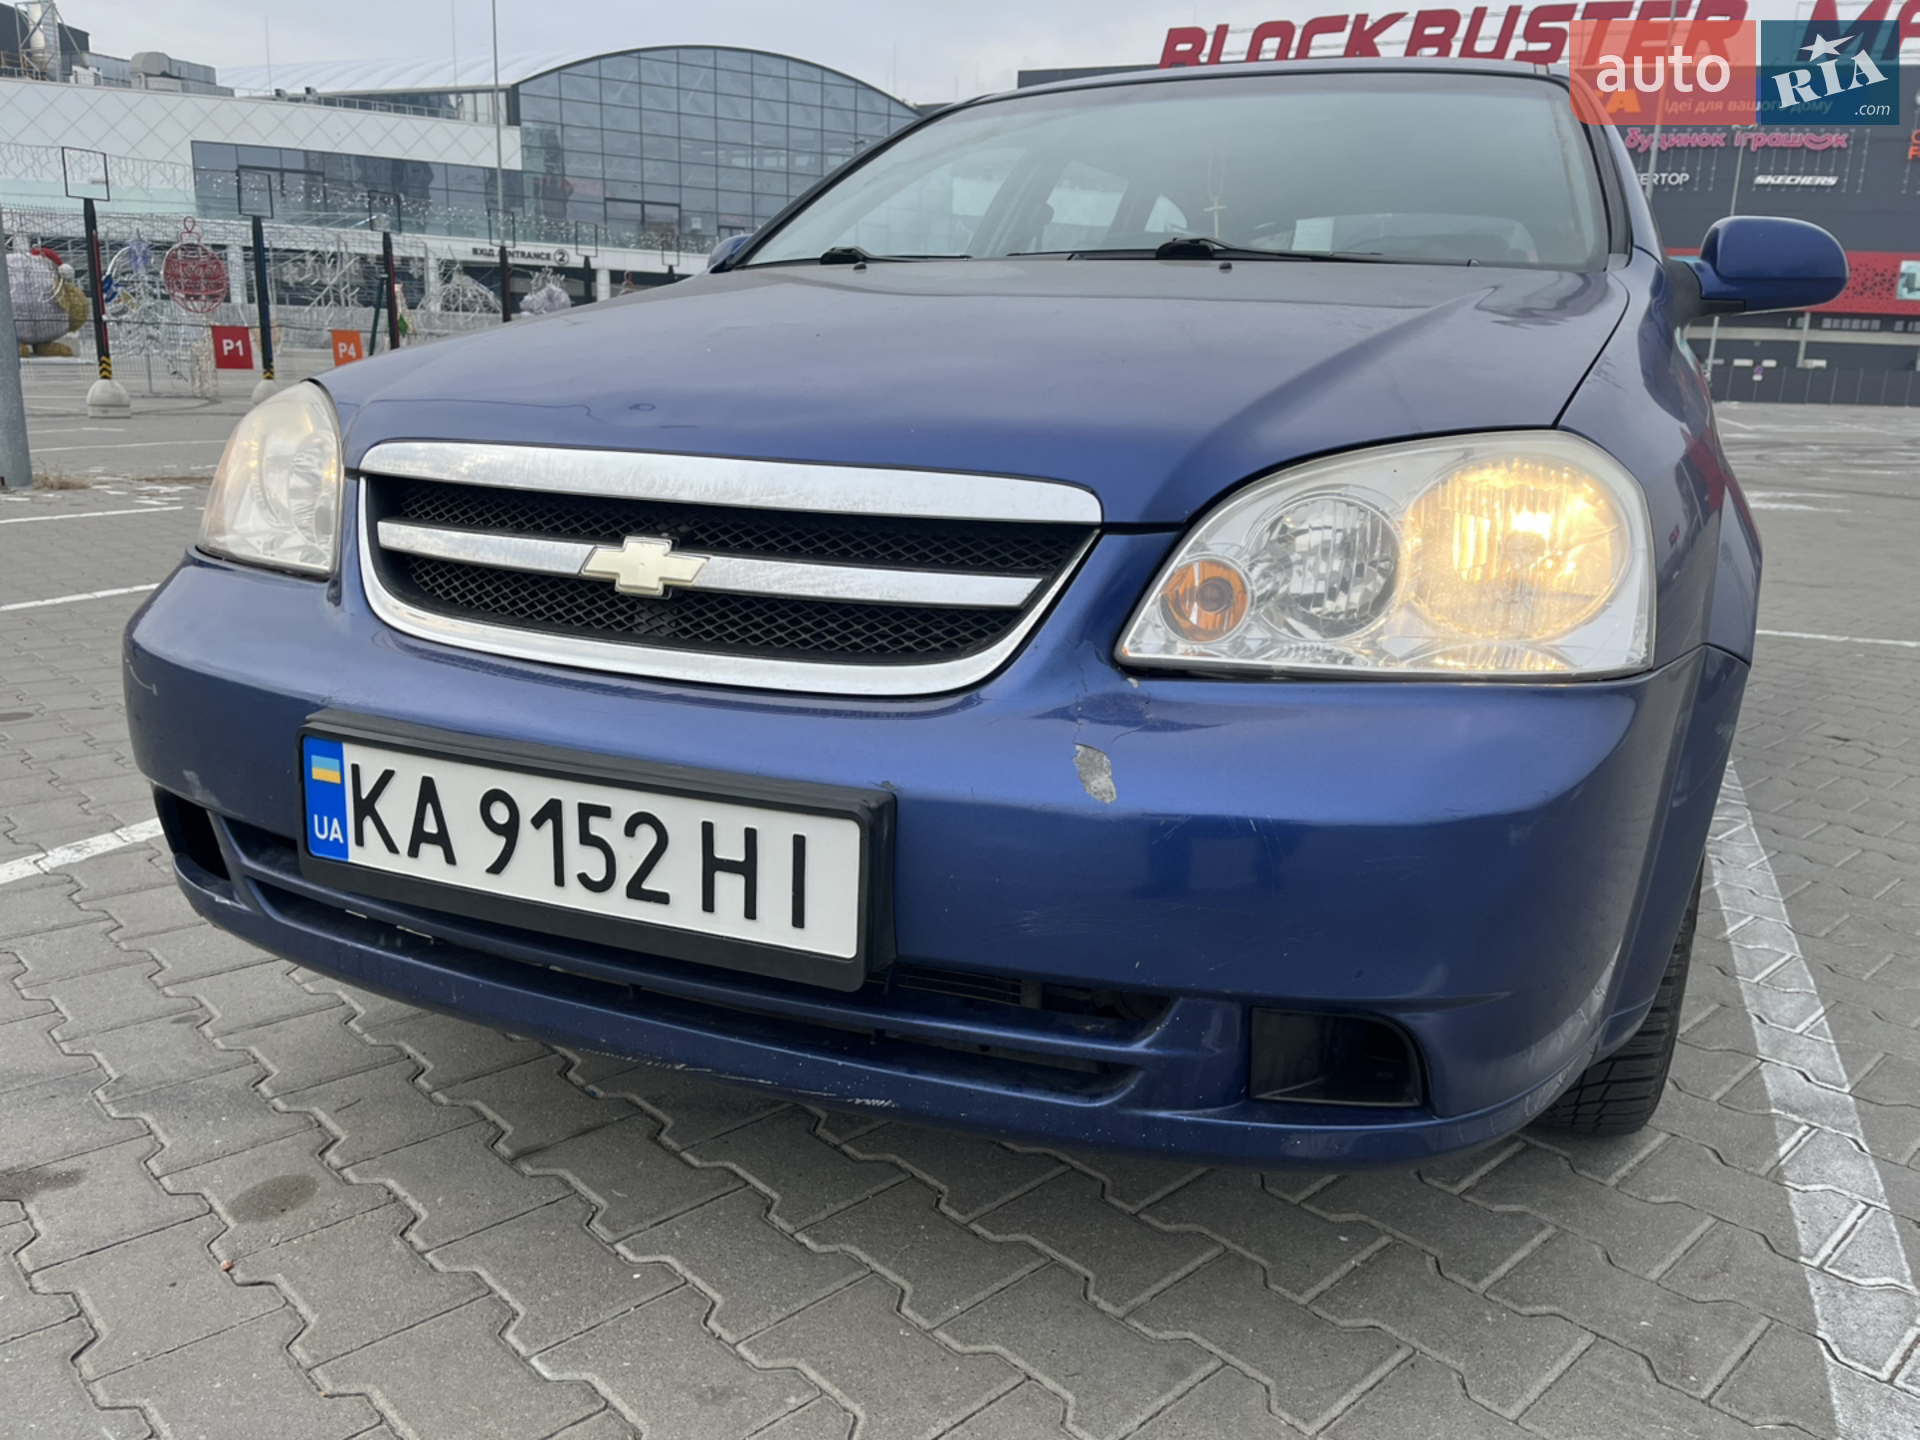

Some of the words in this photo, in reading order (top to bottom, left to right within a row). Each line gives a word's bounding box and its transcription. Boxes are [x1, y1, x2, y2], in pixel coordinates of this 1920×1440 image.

[1637, 172, 1690, 185] ERTOP
[1753, 174, 1839, 186] SKECHERS
[506, 250, 552, 261] NTRANCE
[222, 339, 244, 357] P1
[337, 342, 357, 358] P4
[313, 813, 344, 844] UA
[350, 763, 458, 866] KA
[479, 787, 671, 906] 9152
[701, 820, 806, 929] HI
